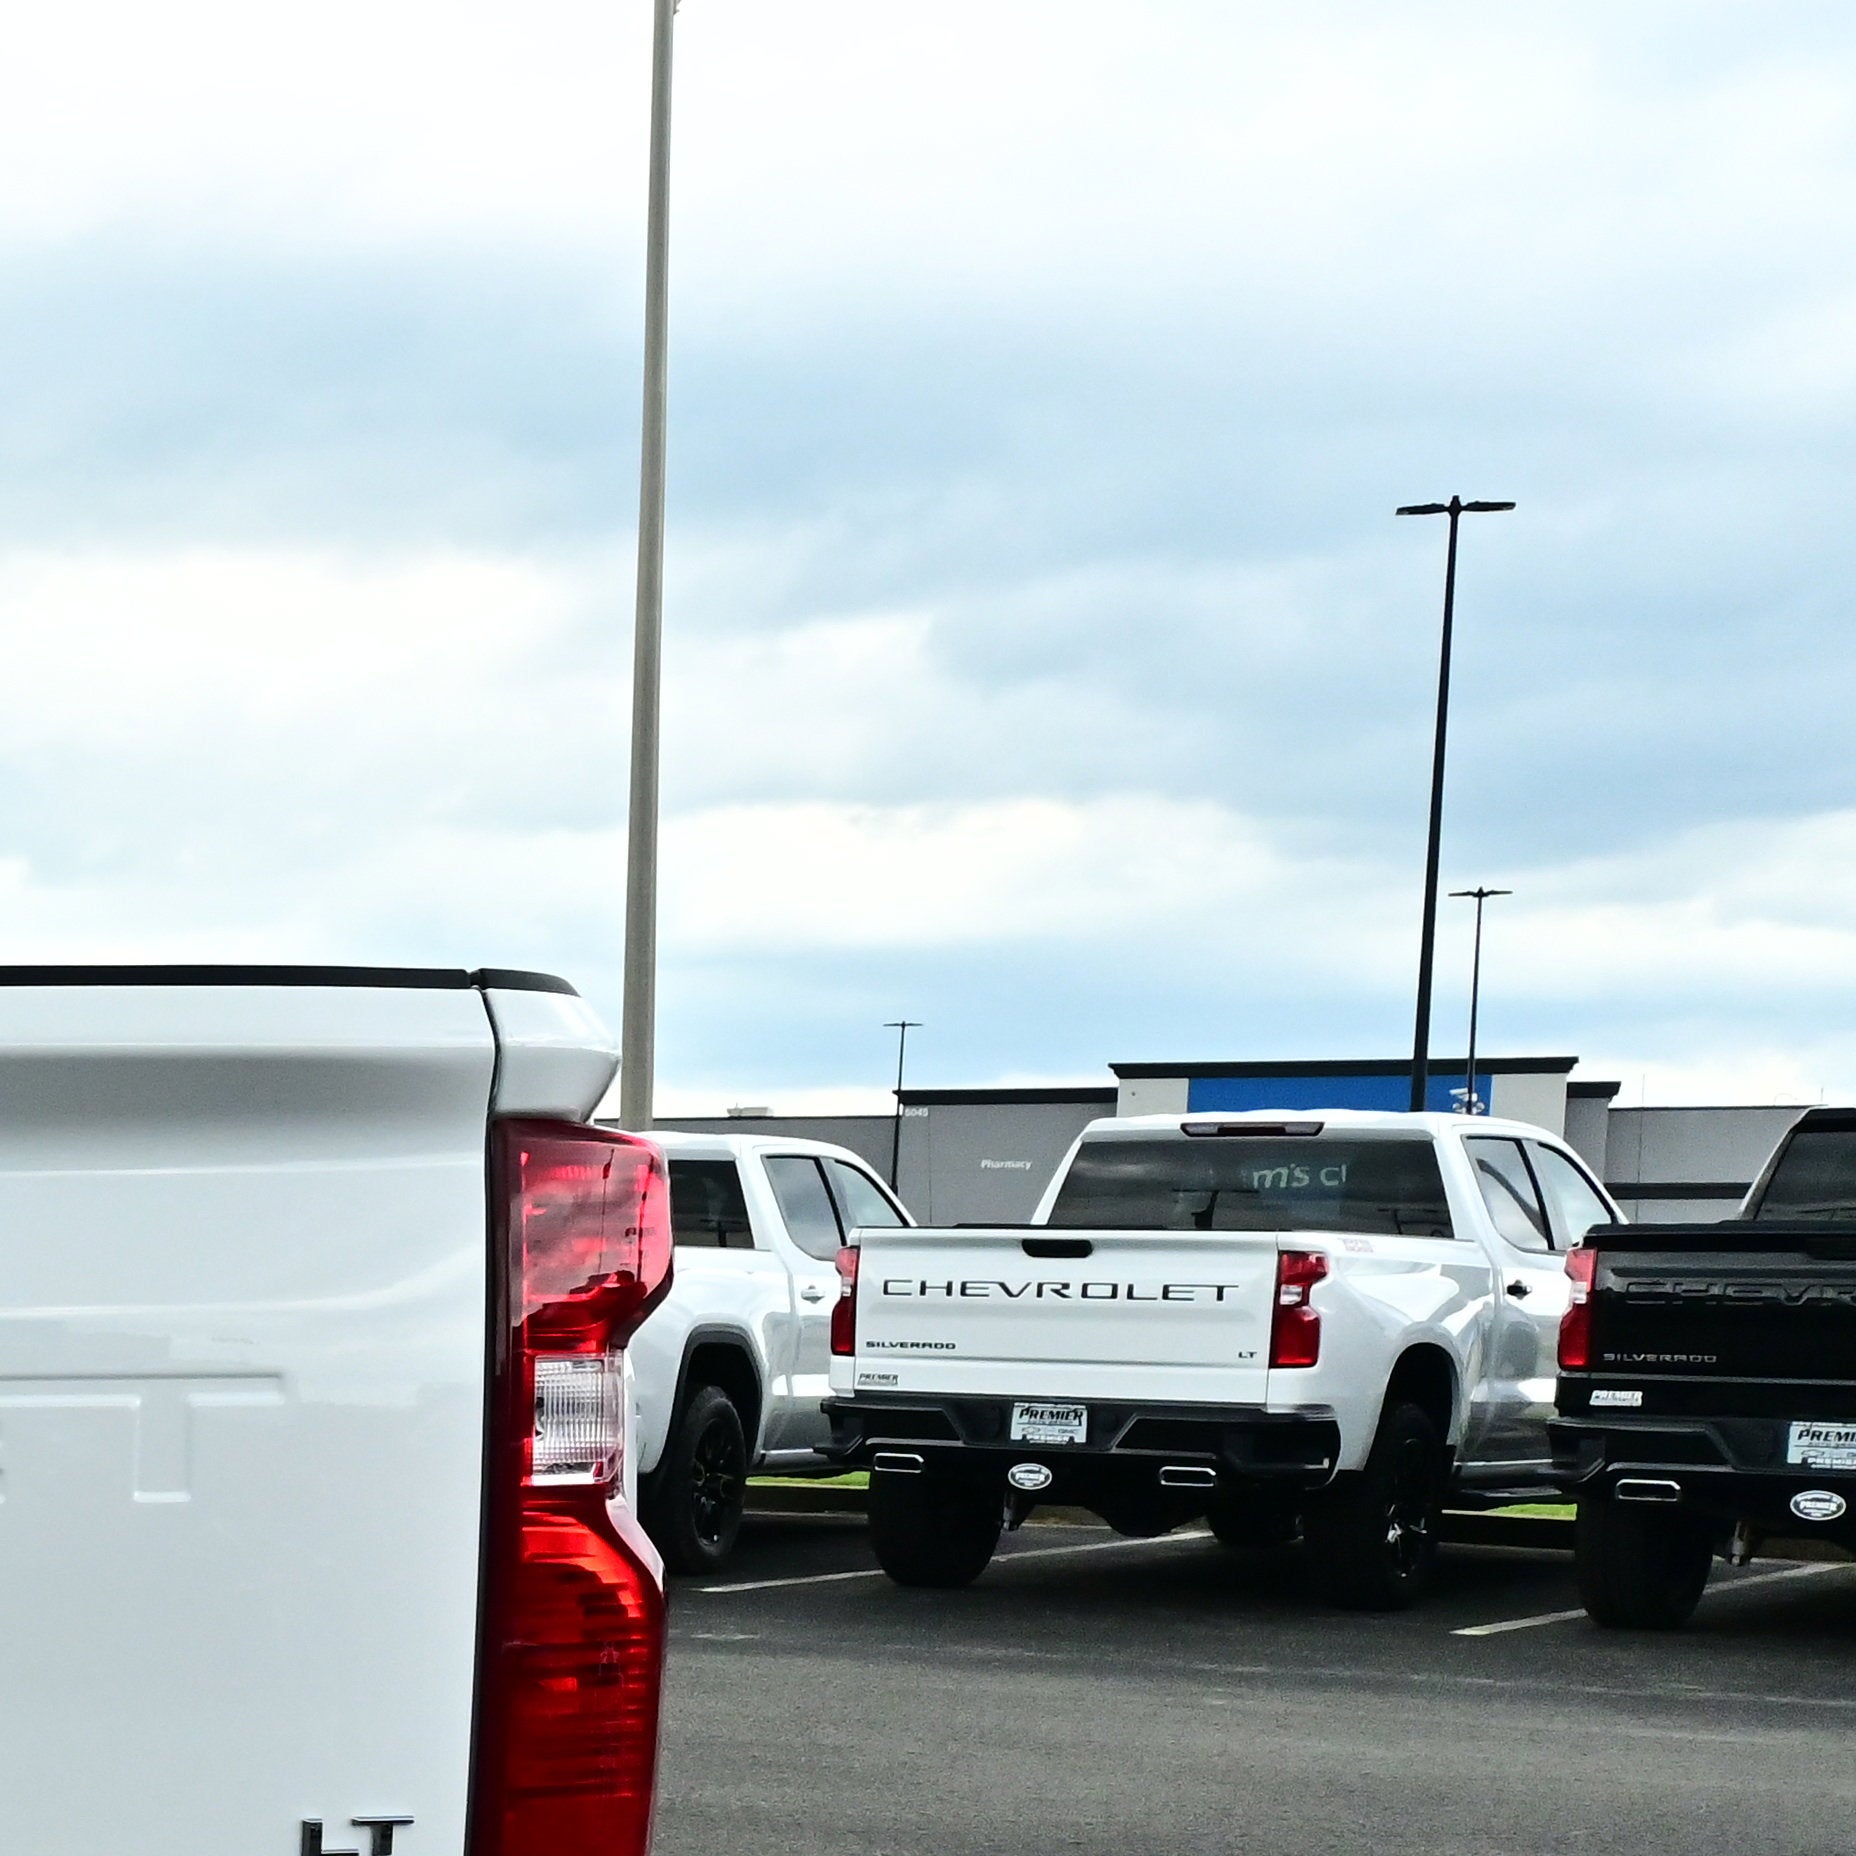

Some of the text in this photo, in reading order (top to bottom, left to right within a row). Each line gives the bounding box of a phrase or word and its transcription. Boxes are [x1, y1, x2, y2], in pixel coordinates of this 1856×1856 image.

[980, 1159, 1032, 1170] Pharmacy
[883, 1280, 1239, 1301] CHEVROLET
[866, 1340, 956, 1350] SILVERADO
[1238, 1351, 1257, 1359] LT
[1603, 1353, 1717, 1363] SILVERADO
[1019, 1408, 1083, 1422] PREMIER
